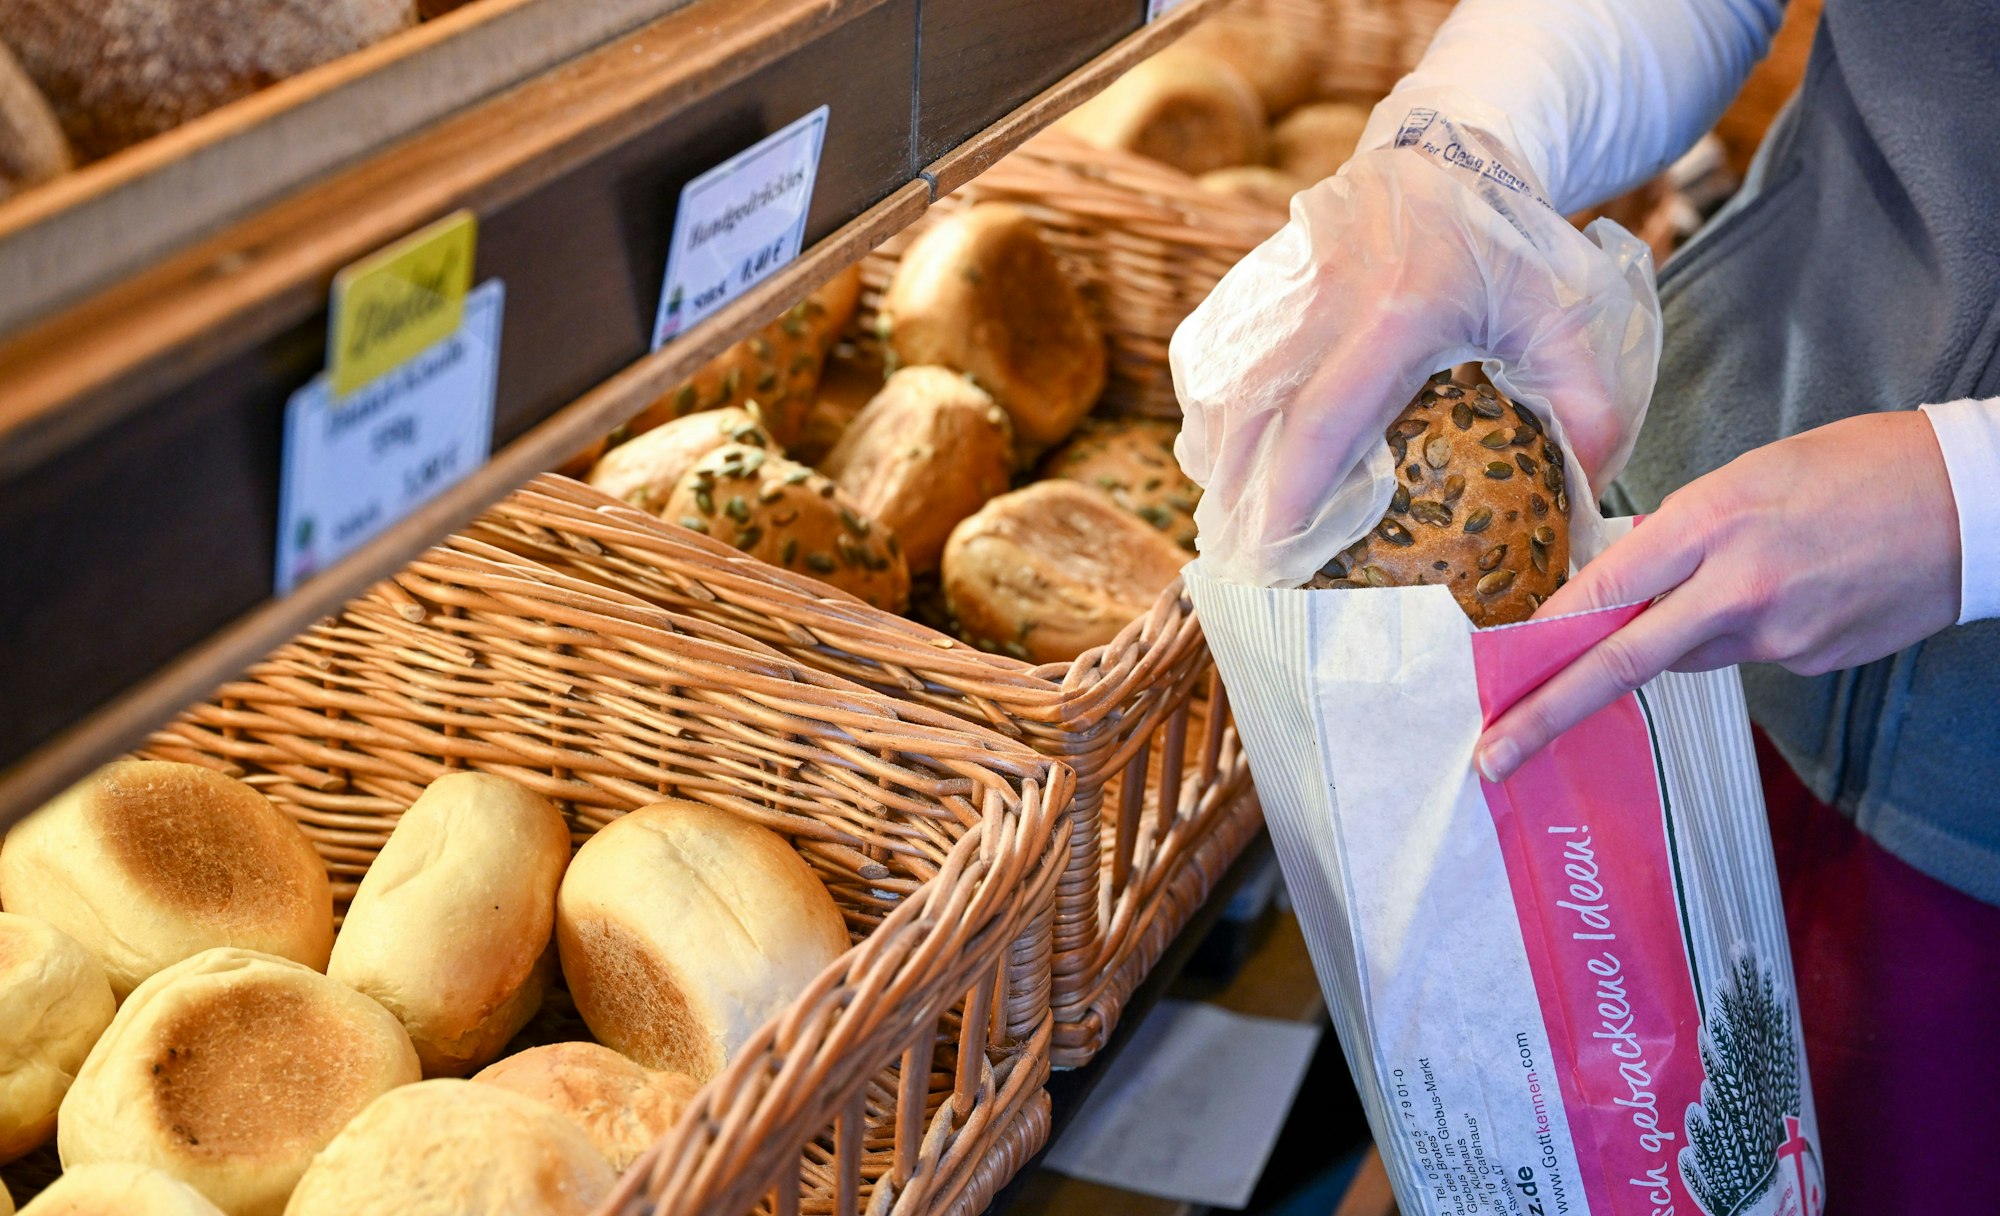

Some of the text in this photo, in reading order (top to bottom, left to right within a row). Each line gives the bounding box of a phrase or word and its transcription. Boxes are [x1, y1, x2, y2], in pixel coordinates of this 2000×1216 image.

[1422, 141, 1440, 155] For
[1443, 142, 1484, 171] Clean
[1547, 824, 1615, 941] Ideen!
[1587, 951, 1676, 1153] gebackene
[1418, 1057, 1450, 1140] Globus-Markt
[1515, 1031, 1569, 1215] www.Gottkennen.com
[1443, 1173, 1459, 1192] des
[1444, 1142, 1456, 1157] im
[1457, 1137, 1490, 1206] im Klubhaus
[1457, 1174, 1478, 1214] Globus
